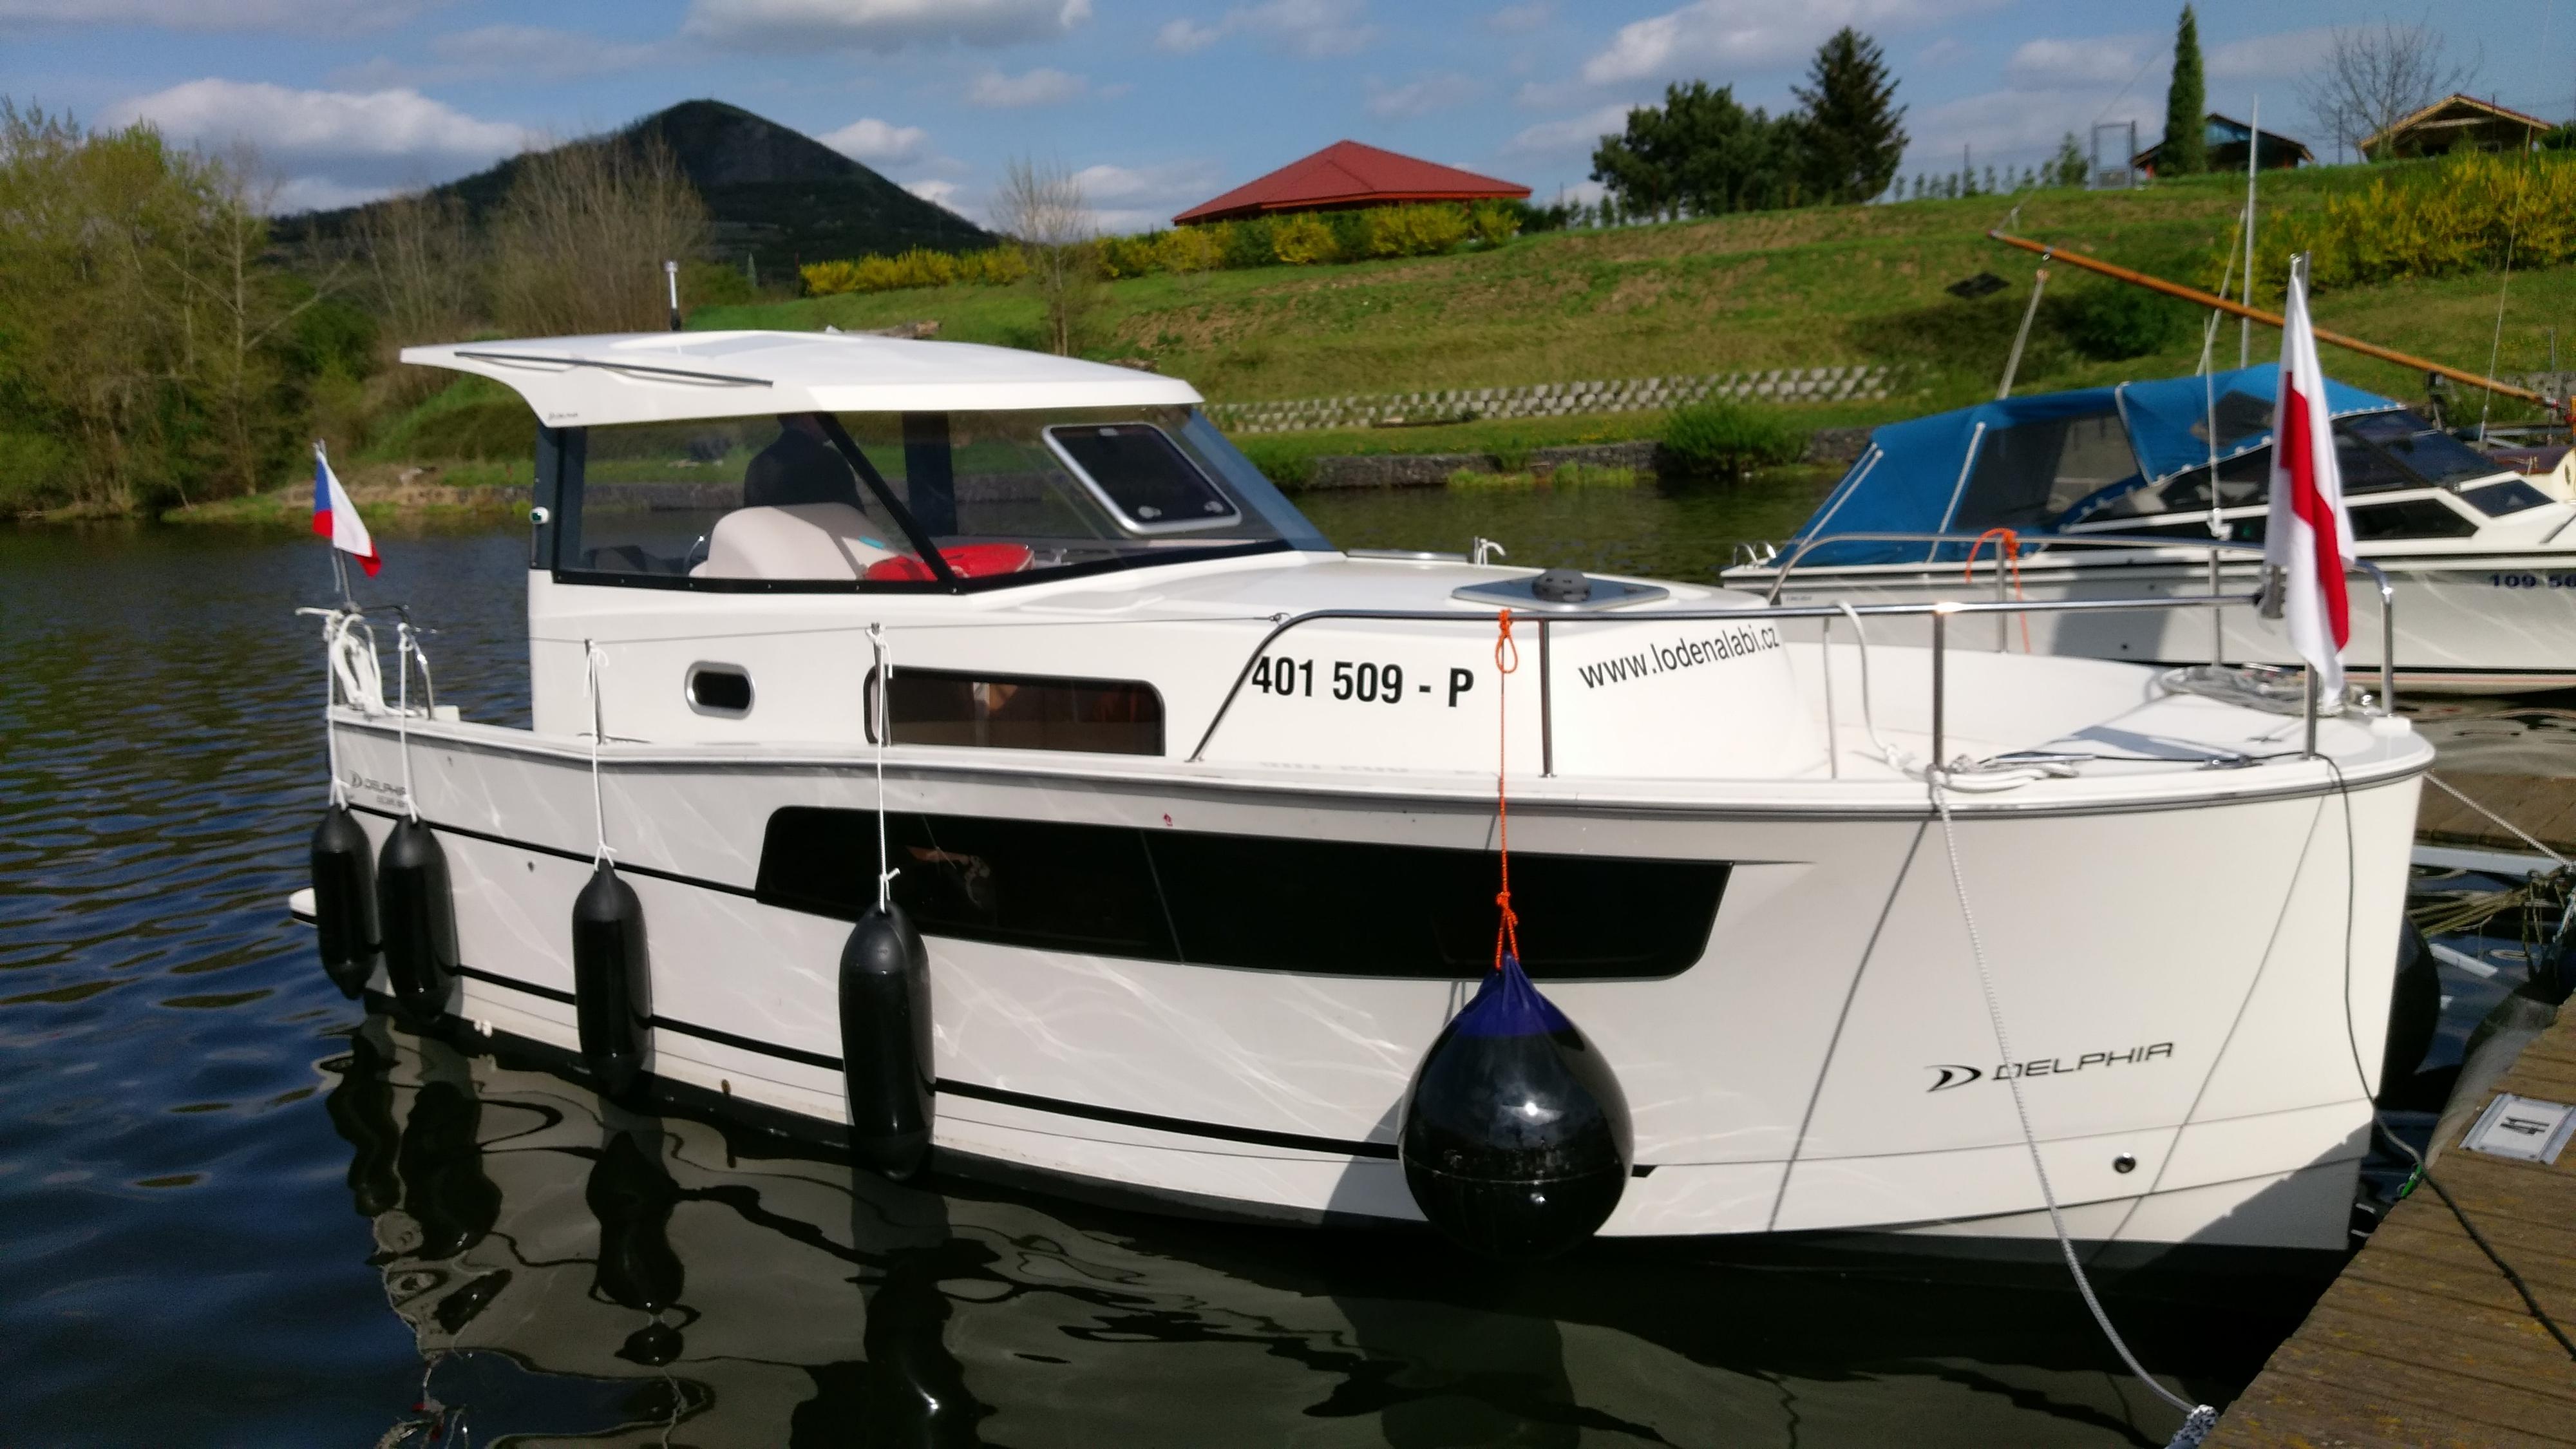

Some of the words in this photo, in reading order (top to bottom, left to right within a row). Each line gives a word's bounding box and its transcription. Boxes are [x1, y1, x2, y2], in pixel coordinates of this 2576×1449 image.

[2490, 573, 2537, 587] 109
[1578, 625, 1780, 688] www.lodenalabi.cz
[1252, 656, 1313, 697] 401
[1333, 661, 1403, 704] 509
[1449, 667, 1473, 708] P
[1992, 1042, 2174, 1081] DELPHIA
